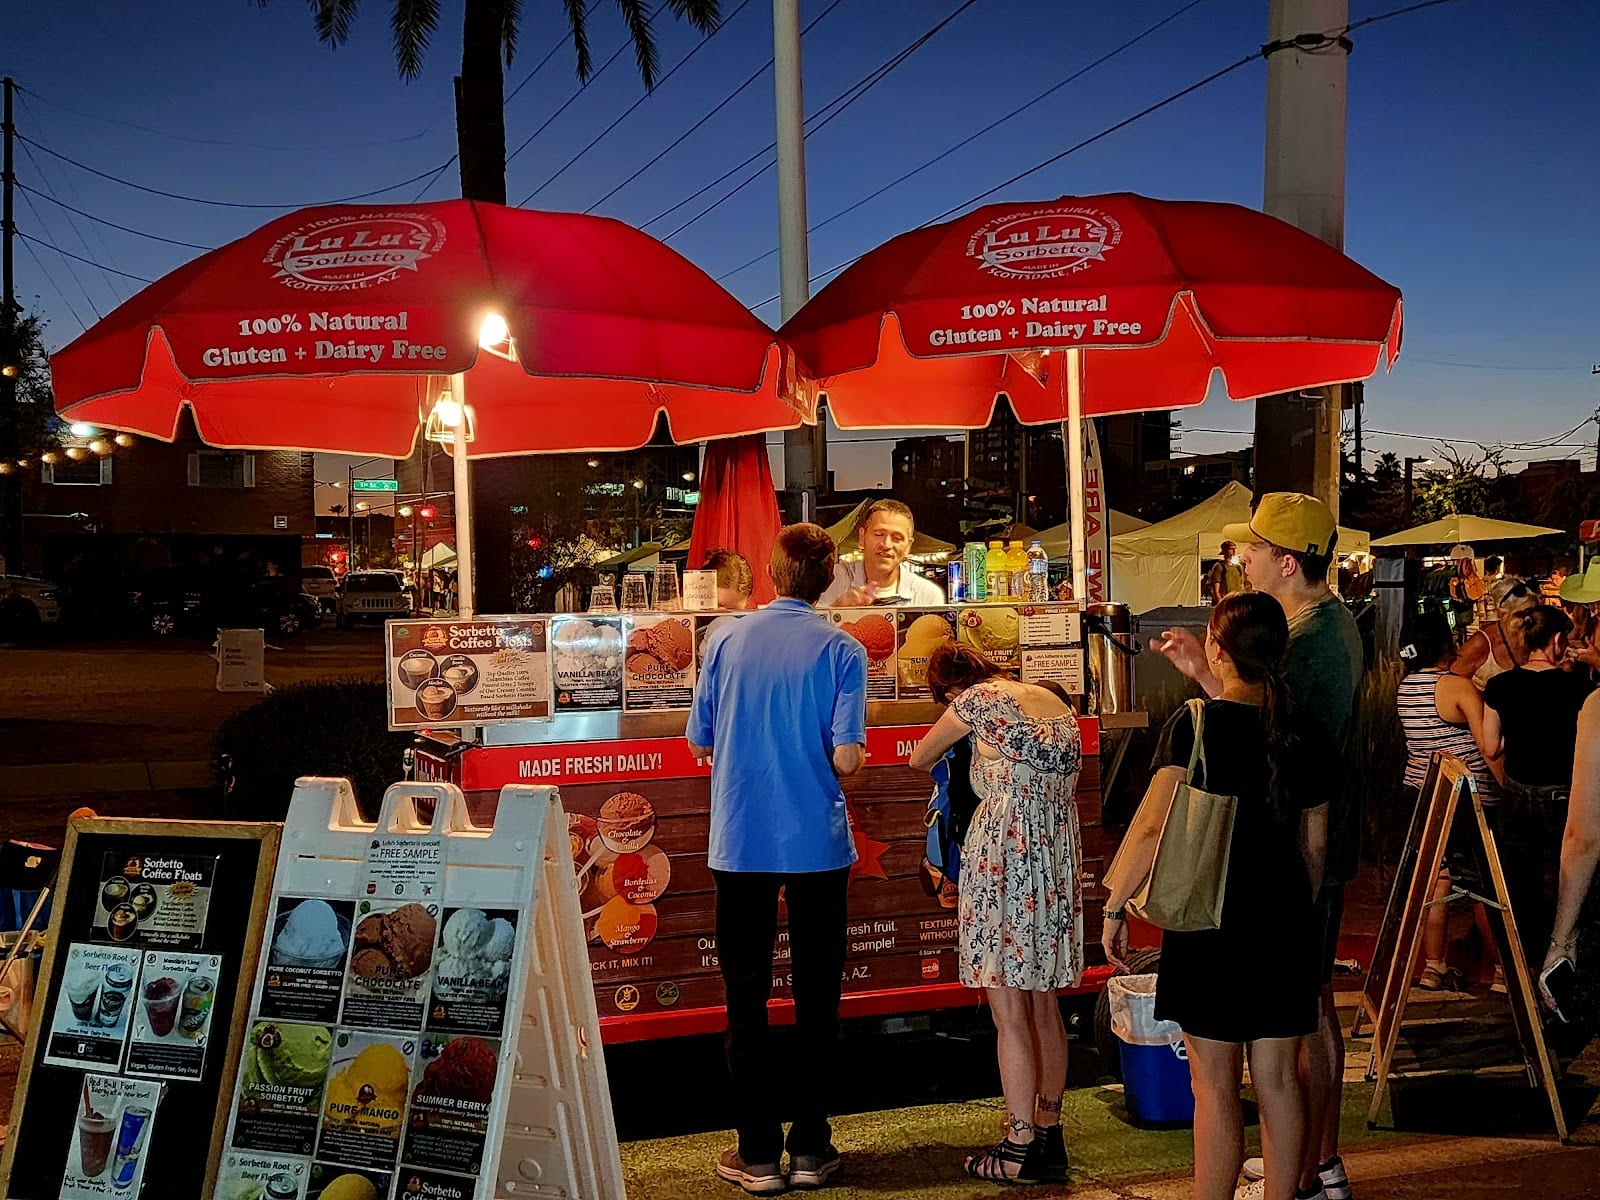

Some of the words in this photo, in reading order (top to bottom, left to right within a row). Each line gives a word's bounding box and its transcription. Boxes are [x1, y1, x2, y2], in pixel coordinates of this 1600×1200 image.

[306, 214, 356, 229] 100%
[991, 212, 1031, 225] 100%
[1033, 207, 1100, 216] NATURAL
[995, 244, 1090, 261] Sorbetto
[294, 251, 405, 268] Sorbetto
[1072, 261, 1092, 273] AZ
[377, 271, 401, 284] AZ
[961, 299, 1016, 320] 100%
[1020, 294, 1108, 315] Natural
[238, 313, 303, 336] 100%
[309, 311, 408, 331] Natural
[929, 328, 1002, 346] Gluten
[1008, 327, 1019, 339] +
[1025, 320, 1087, 340] Dairy
[1092, 318, 1142, 336] Free
[202, 347, 287, 367] Gluten
[295, 347, 306, 360] +
[314, 340, 385, 363] Dairy
[391, 339, 447, 360] Free
[449, 625, 504, 637] Sorbetto
[449, 637, 493, 649] Coffee
[495, 636, 533, 648] Floats
[647, 663, 672, 671] PURE
[1033, 660, 1050, 668] FREE
[1051, 659, 1077, 667] SAMPLE
[557, 671, 594, 679] VANILLA
[596, 670, 618, 678] BEAN
[632, 672, 687, 681] CHOCOLATE
[518, 760, 561, 779] MADE
[564, 756, 614, 776] FRESH
[617, 752, 663, 774] DAILY!
[608, 829, 643, 838] Chocolate
[380, 848, 402, 858] FREE
[403, 848, 439, 859] SAMPLE
[143, 857, 183, 869] Sorbetto
[142, 868, 172, 879] Coffee
[174, 869, 203, 881] Floats
[624, 877, 657, 888] Bordeaux
[627, 890, 657, 900] Coconut
[615, 924, 640, 934] Mango
[846, 922, 871, 936] resh
[874, 920, 899, 934] fruit.
[919, 918, 960, 930] TEXTURA
[610, 936, 649, 946] Strawberry
[920, 930, 958, 941] WITHOUT
[852, 936, 895, 952] sample!
[83, 950, 112, 960] Sorbetto
[112, 953, 128, 962] Root
[701, 955, 719, 967] It's
[85, 962, 100, 971] Beer
[609, 959, 620, 970] IT,
[622, 958, 639, 968] MIX
[641, 956, 653, 966] IT!
[313, 969, 342, 977] SORBETTO
[374, 965, 404, 976] PURE
[773, 975, 783, 987] in
[852, 966, 872, 979] AZ.
[354, 976, 421, 990] CHOCOLATE
[437, 976, 477, 988] VANILLA
[249, 1082, 286, 1093] PASSION
[287, 1086, 314, 1096] FRUIT
[260, 1092, 304, 1104] SORBETTO
[417, 1094, 455, 1108] SUMMER
[457, 1099, 487, 1112] BERRY
[330, 1102, 358, 1115] PURE
[360, 1107, 399, 1120] MANGO
[239, 1157, 271, 1169] Sorbetto
[273, 1161, 291, 1171] Root
[241, 1171, 259, 1180] Beer
[421, 1181, 462, 1199] Sorbetto
